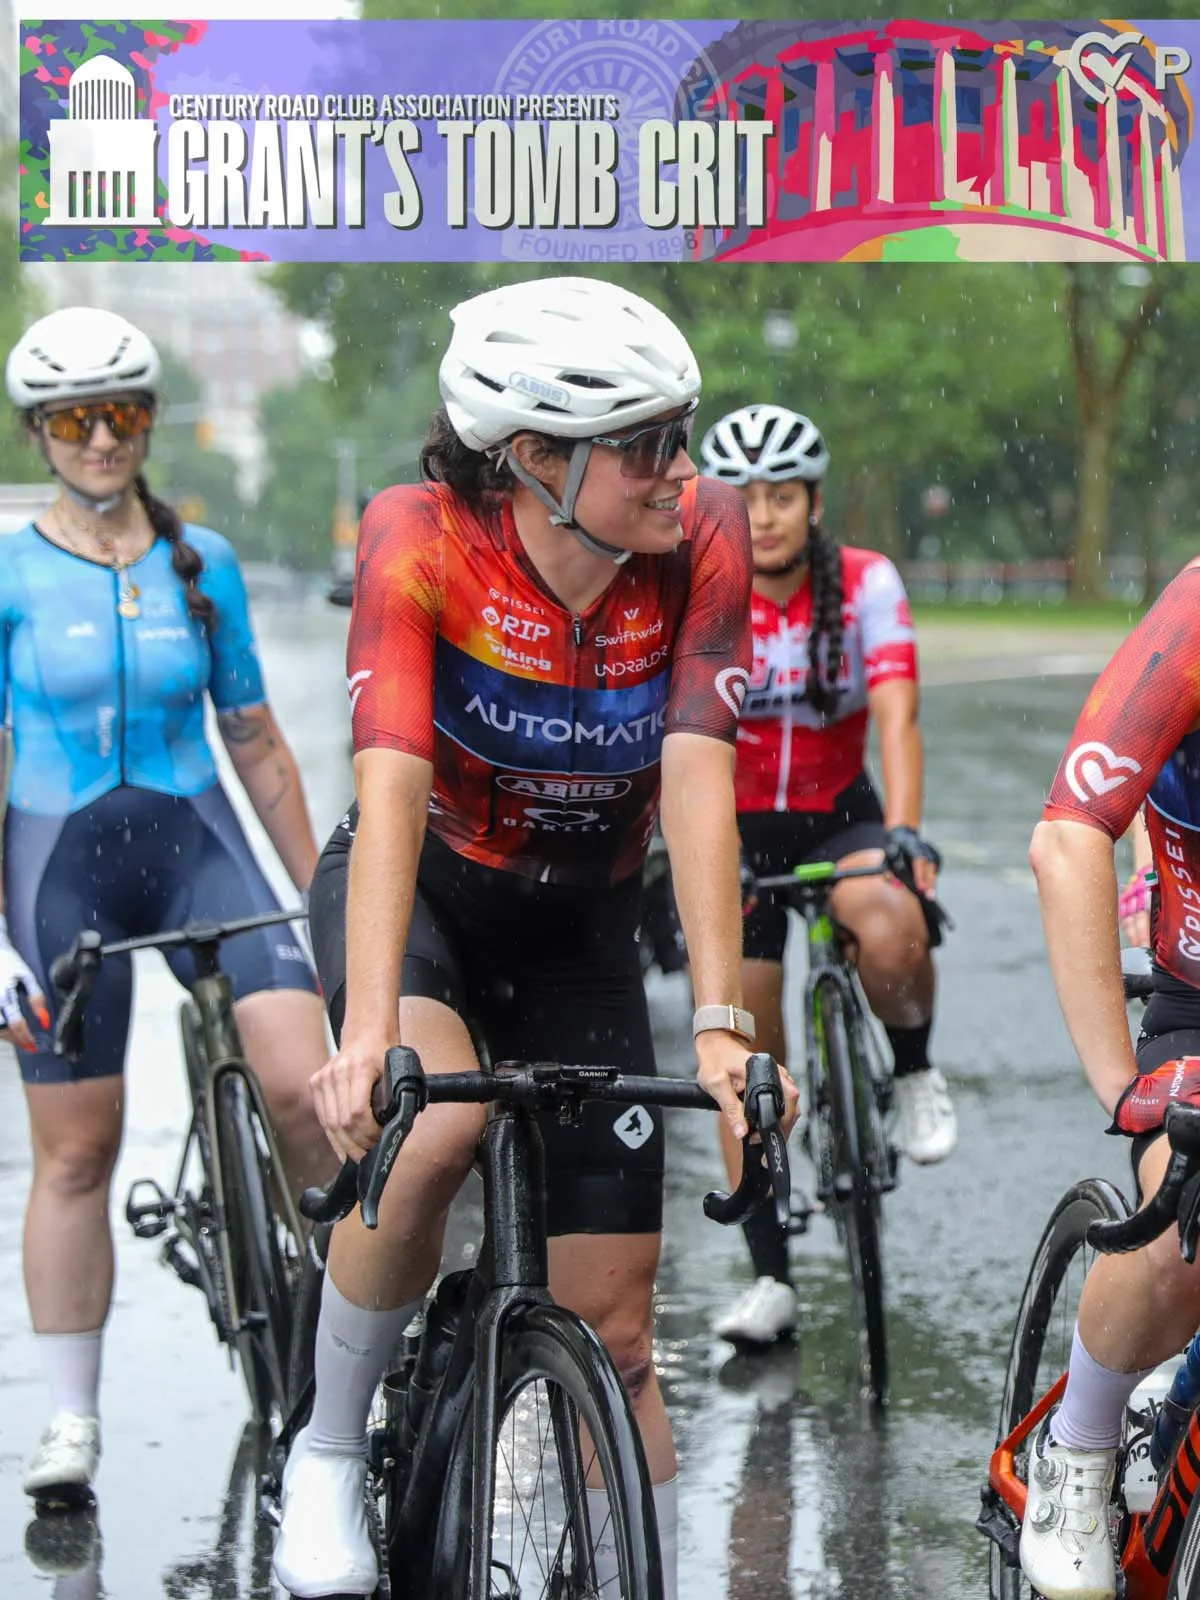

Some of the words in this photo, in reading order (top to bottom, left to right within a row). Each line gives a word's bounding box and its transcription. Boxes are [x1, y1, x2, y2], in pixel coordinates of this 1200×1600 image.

[500, 613, 551, 643] RIP
[490, 642, 553, 672] viking
[511, 779, 616, 798] ABUS
[578, 1070, 609, 1078] GARMIN
[769, 1131, 784, 1174] GRX
